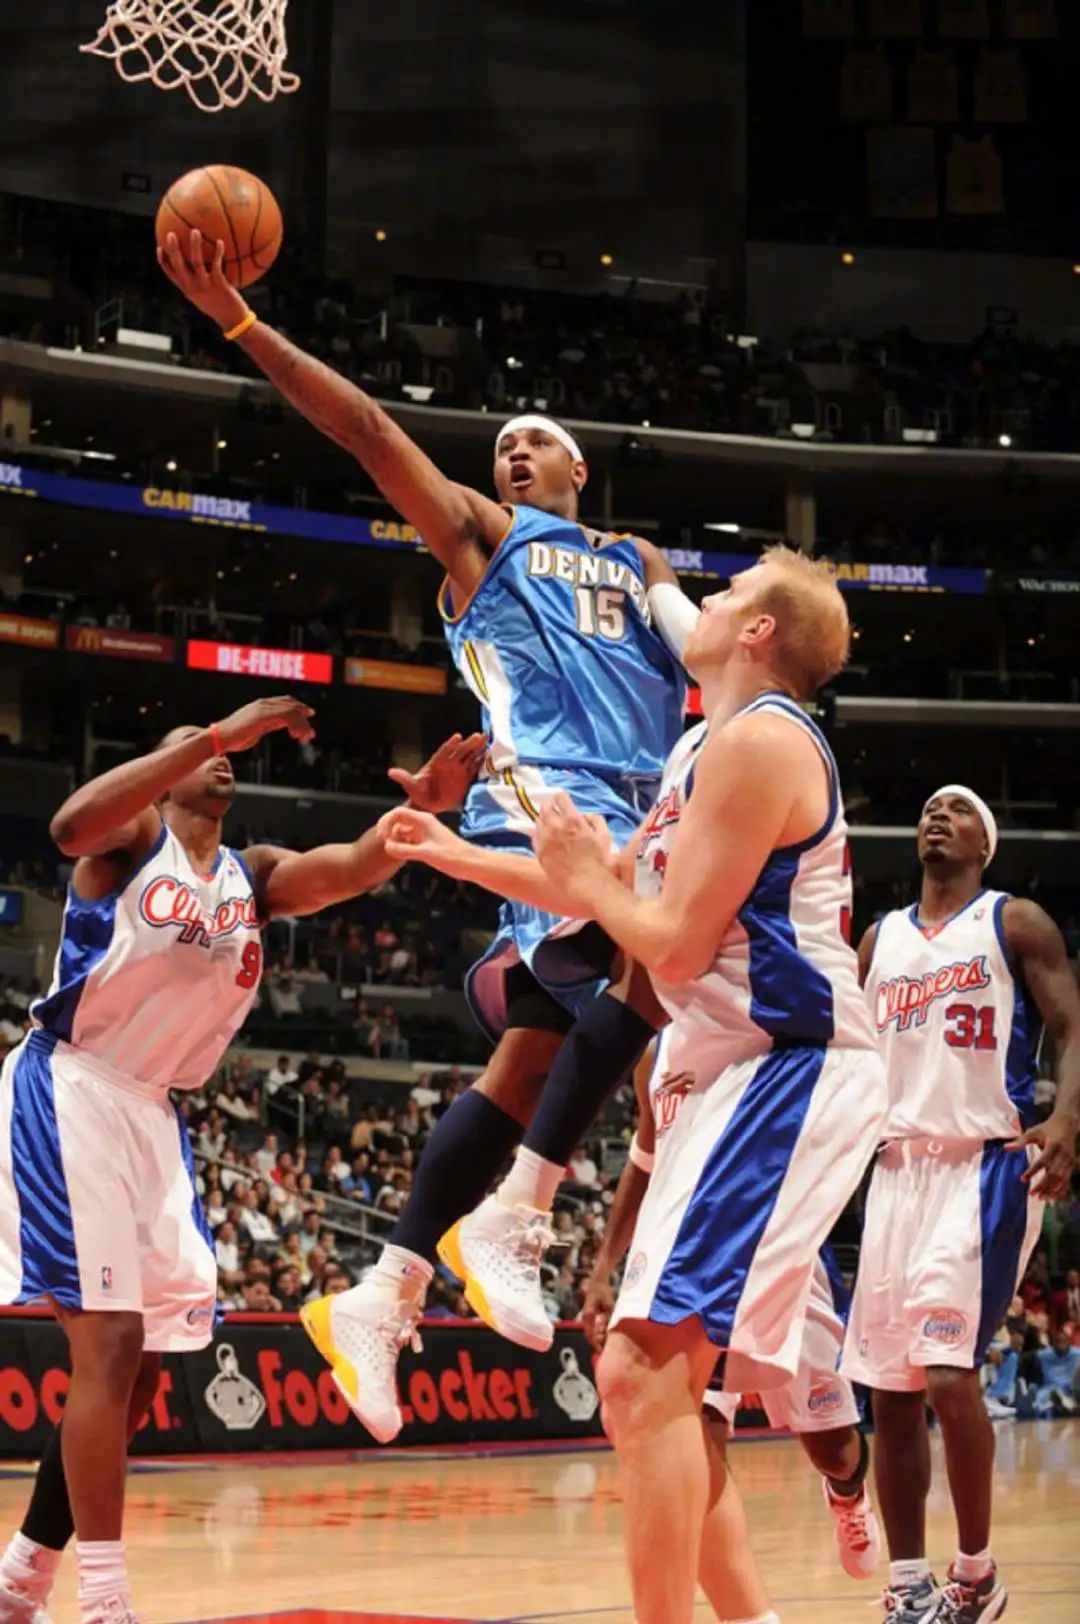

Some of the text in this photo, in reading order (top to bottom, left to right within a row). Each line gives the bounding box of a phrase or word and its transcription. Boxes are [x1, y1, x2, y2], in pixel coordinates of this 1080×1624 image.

[142, 487, 251, 520] CARmax
[370, 519, 423, 544] CAR
[528, 540, 652, 628] DENVE
[575, 585, 628, 642] 15
[217, 646, 306, 681] DE-FENSE
[235, 940, 260, 989] 9
[876, 955, 992, 1034] Clippers
[944, 1003, 998, 1051] 31
[257, 1350, 350, 1428] Foo
